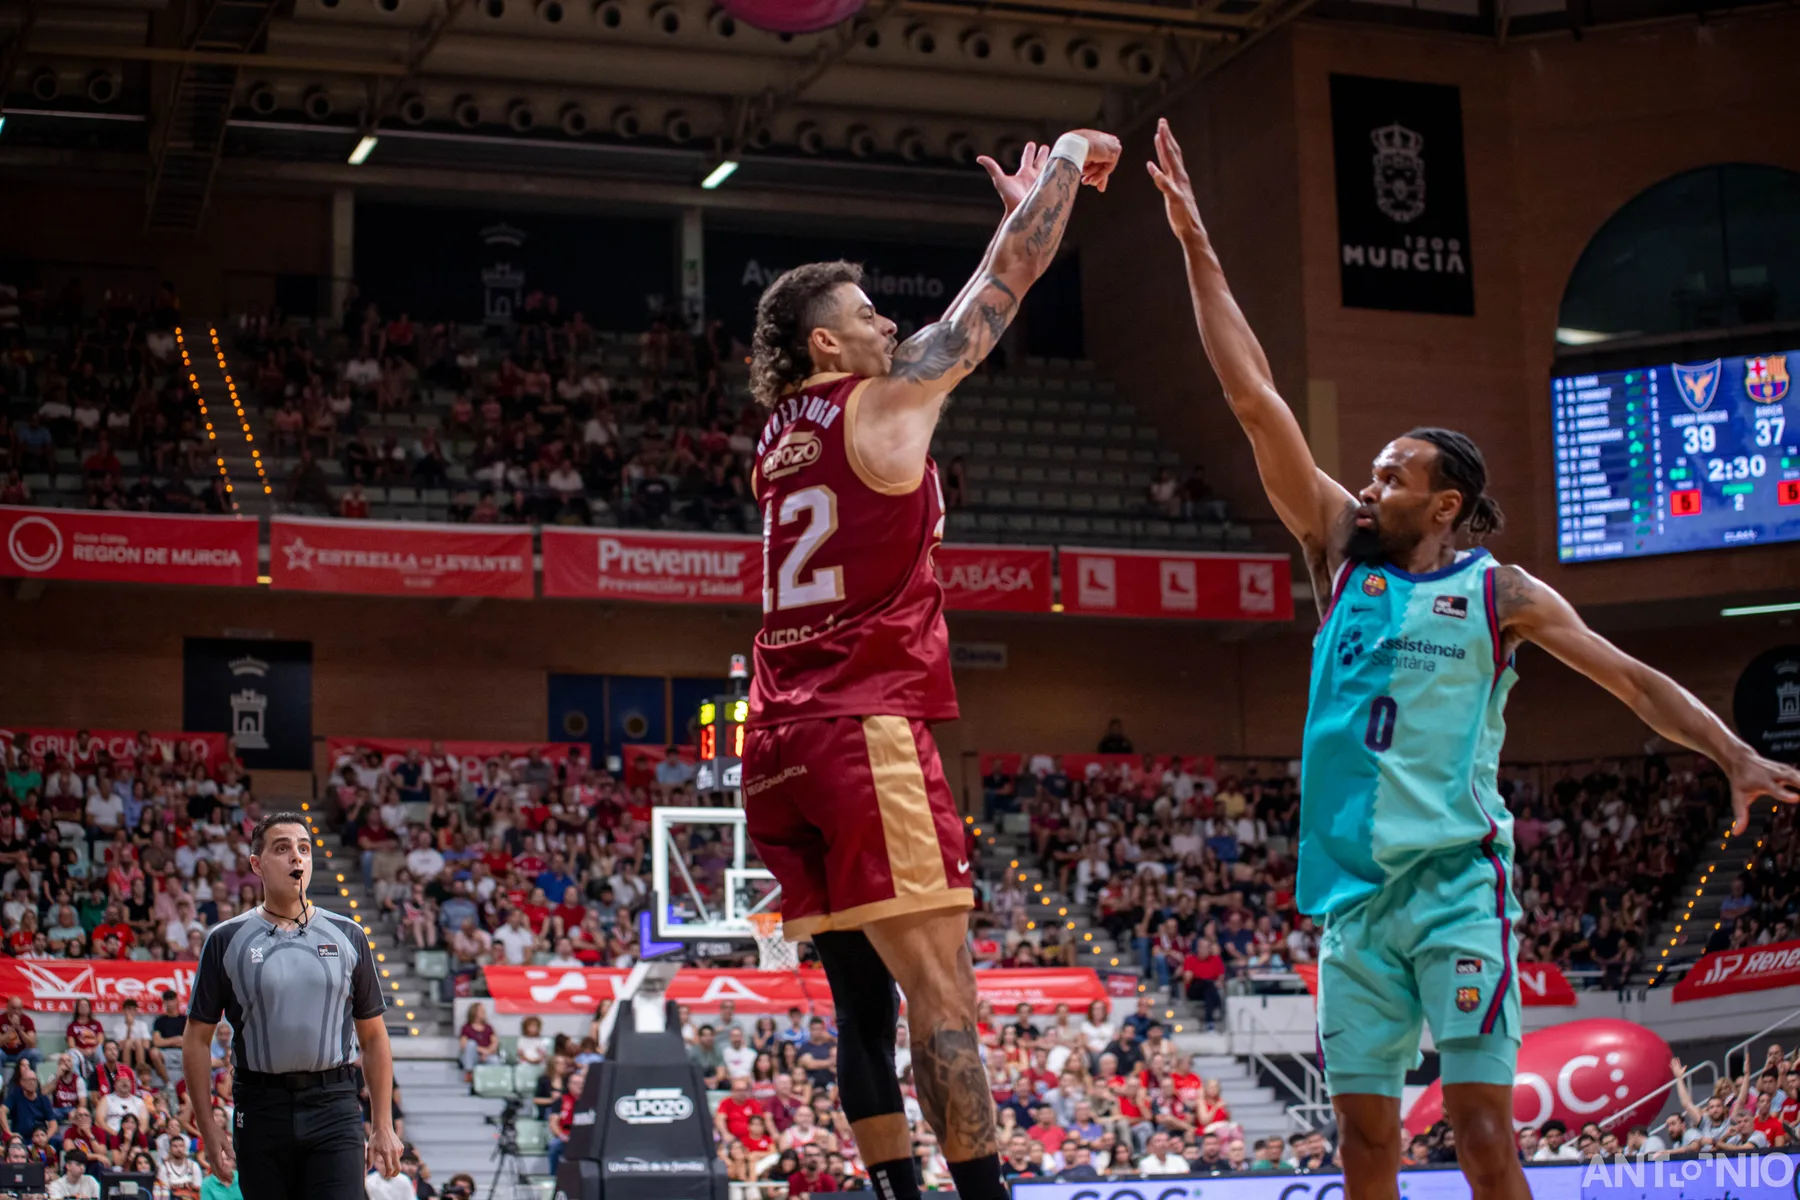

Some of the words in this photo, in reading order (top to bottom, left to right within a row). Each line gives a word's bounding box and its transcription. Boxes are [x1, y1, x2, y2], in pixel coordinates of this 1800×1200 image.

[1342, 245, 1465, 274] MURCIA
[1683, 424, 1716, 454] 39
[1755, 416, 1785, 447] 37
[1708, 454, 1766, 482] 2:30
[145, 548, 166, 564] DE
[172, 548, 242, 567] MURCIA
[317, 549, 418, 569] ESTRELLA
[435, 554, 523, 572] LEVANTE
[598, 538, 745, 577] Prevemur
[701, 580, 743, 596] Salud
[1373, 636, 1466, 660] Assistència
[1371, 651, 1436, 673] Sanitària
[1364, 696, 1398, 753] 0
